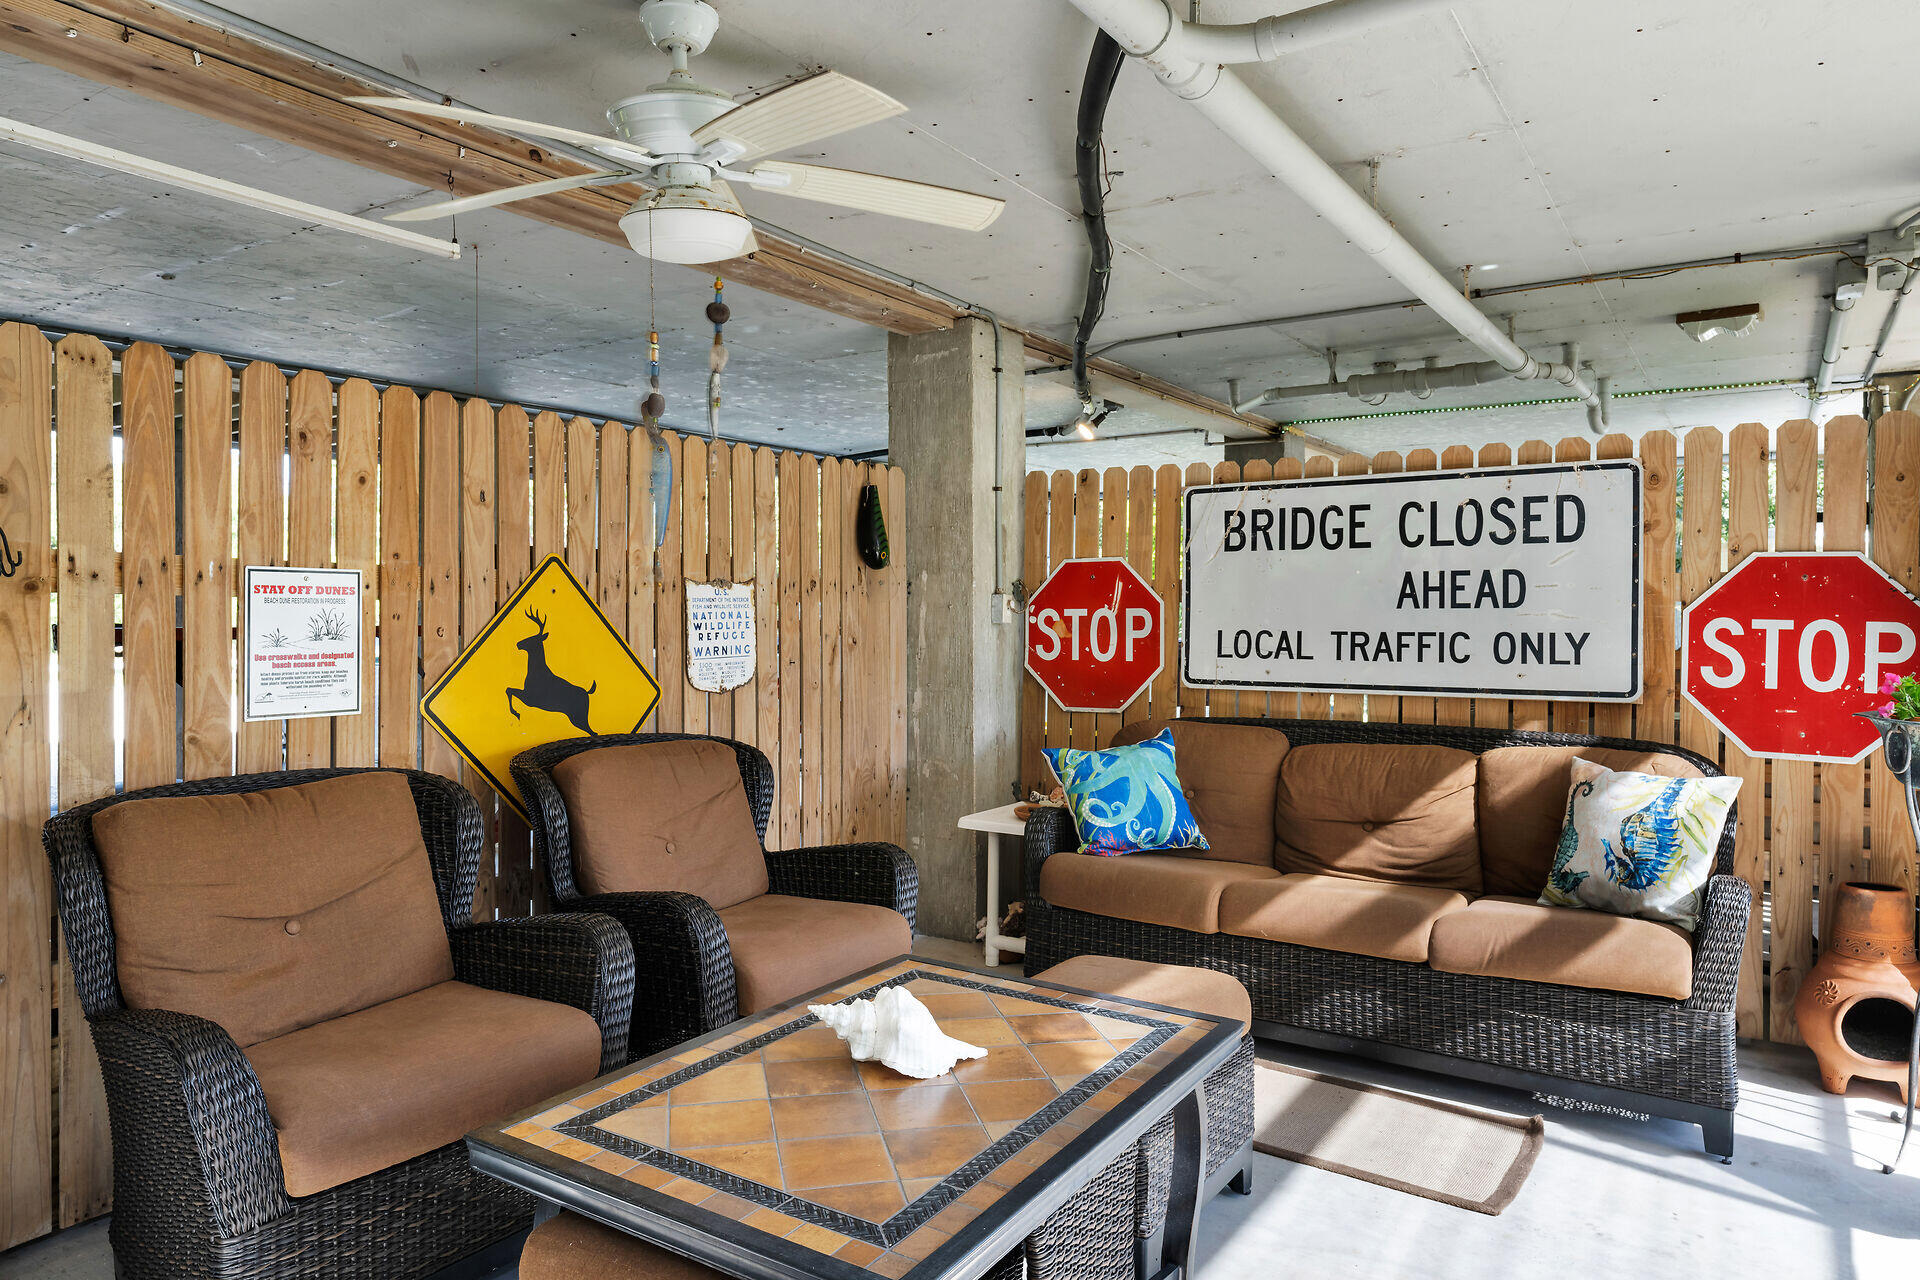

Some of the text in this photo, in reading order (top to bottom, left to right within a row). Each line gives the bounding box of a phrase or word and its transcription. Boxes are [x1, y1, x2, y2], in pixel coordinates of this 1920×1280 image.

[1223, 494, 1586, 552] BRIDGE CLOSED
[253, 584, 356, 596] STAY OFF DUNES
[1396, 568, 1527, 610] AHEAD
[325, 597, 346, 605] PROGRESS
[692, 611, 750, 620] NATIONAL
[693, 621, 750, 631] WILDLIFE
[698, 631, 745, 641] REFUGE
[1035, 607, 1153, 662] STOP
[693, 644, 751, 657] WARNING
[1216, 629, 1591, 665] LOCAL TRAFFIC ONLY
[268, 653, 307, 661] crosswalks
[308, 652, 320, 660] and
[321, 651, 354, 660] designated
[1700, 616, 1916, 694] STOP
[272, 661, 292, 669] beach
